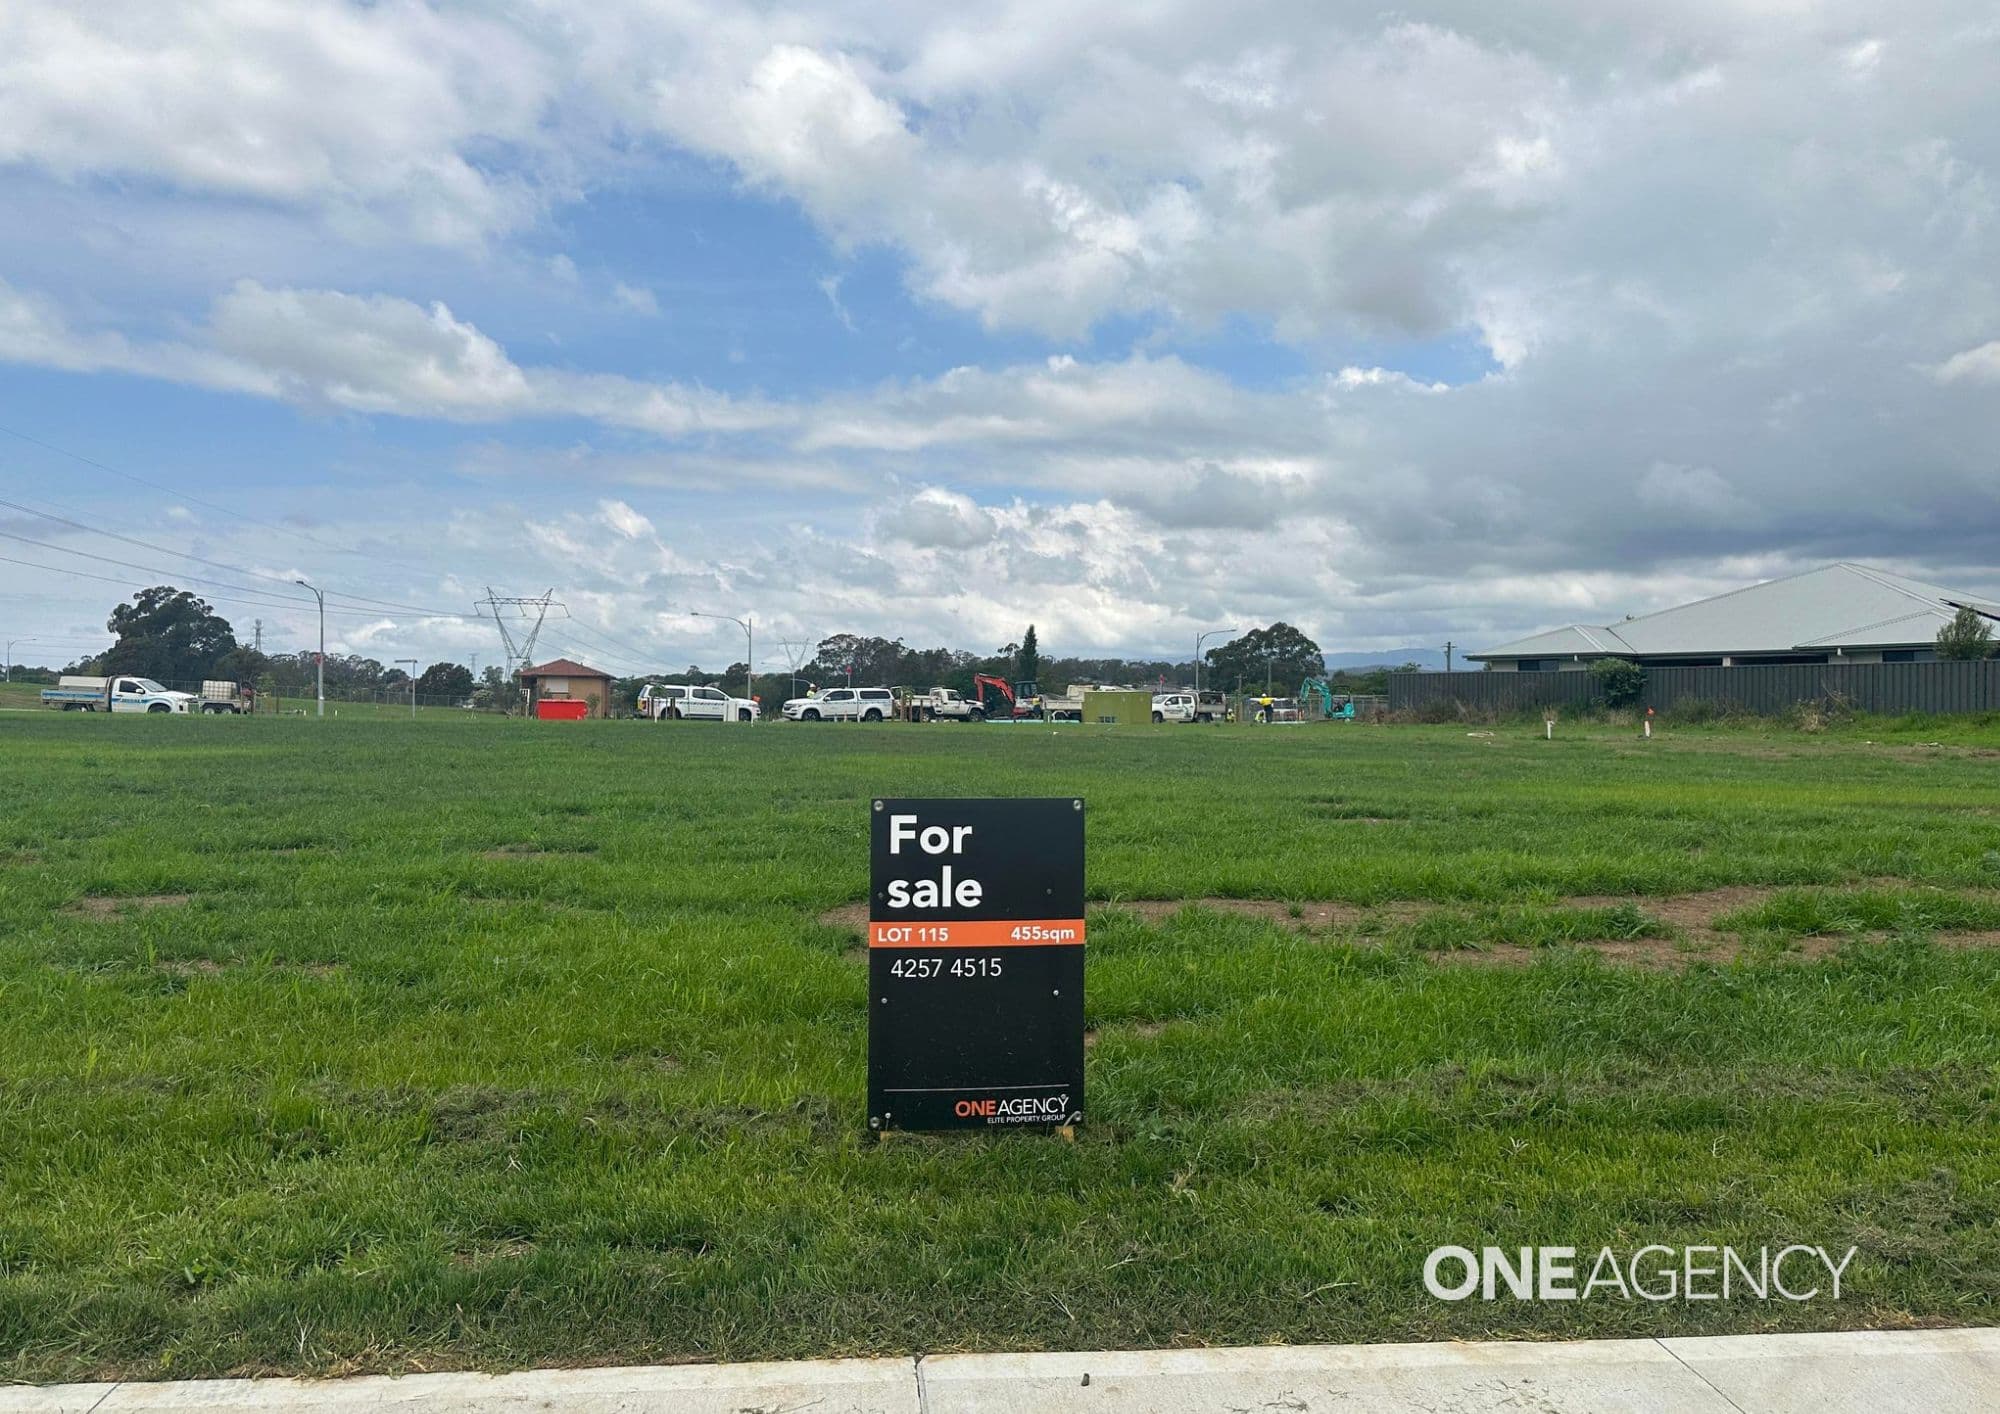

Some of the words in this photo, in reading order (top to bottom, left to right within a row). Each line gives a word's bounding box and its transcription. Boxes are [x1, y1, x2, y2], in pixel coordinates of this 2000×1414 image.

[890, 815, 972, 854] For
[888, 865, 982, 908] sale
[878, 928, 912, 942] LOT
[919, 928, 948, 941] 115
[1011, 926, 1074, 942] 455sqm
[891, 959, 942, 977] 4257
[951, 958, 1001, 977] 4515
[1006, 1115, 1041, 1124] PROPERTY
[1041, 1114, 1067, 1123] GROUP
